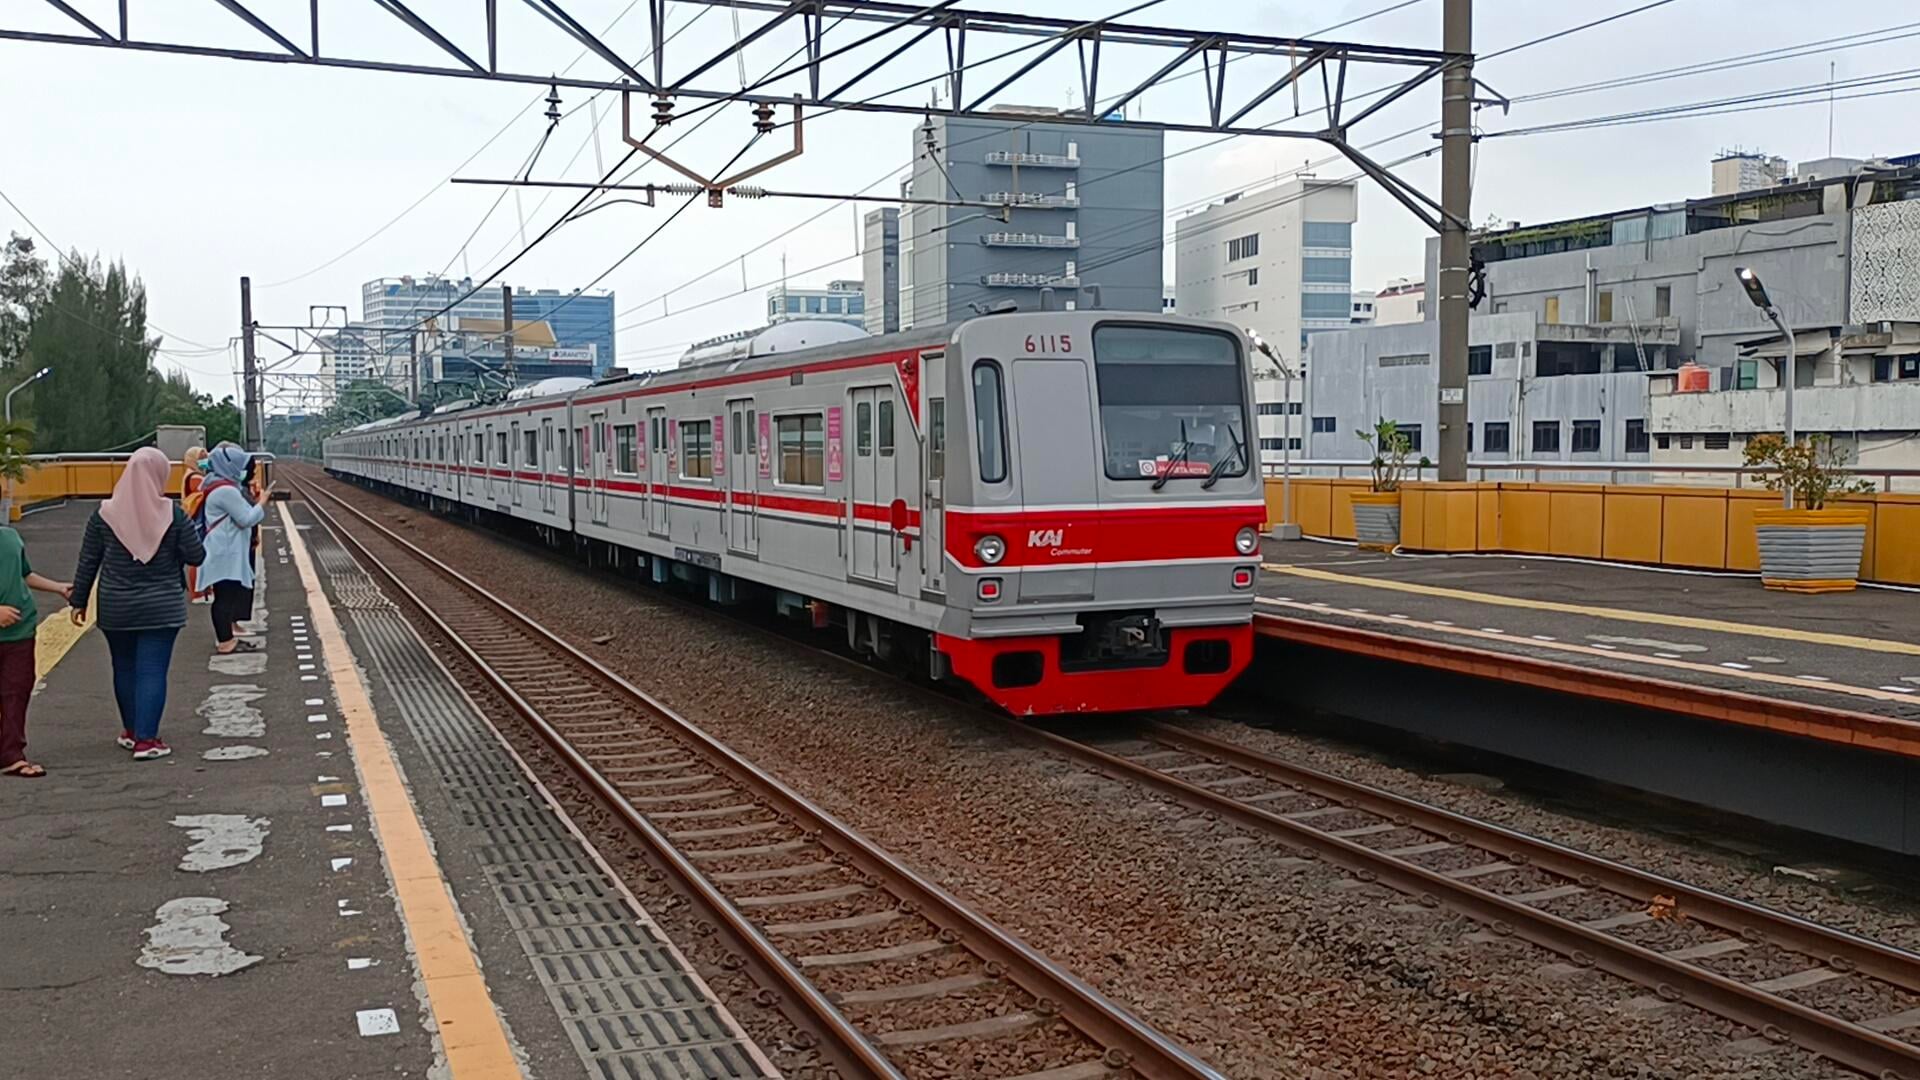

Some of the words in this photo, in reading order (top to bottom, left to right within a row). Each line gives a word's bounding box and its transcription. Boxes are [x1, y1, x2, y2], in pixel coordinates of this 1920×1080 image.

[1025, 334, 1072, 353] 6115
[1027, 529, 1064, 547] KAI
[1050, 548, 1092, 557] Commuter
